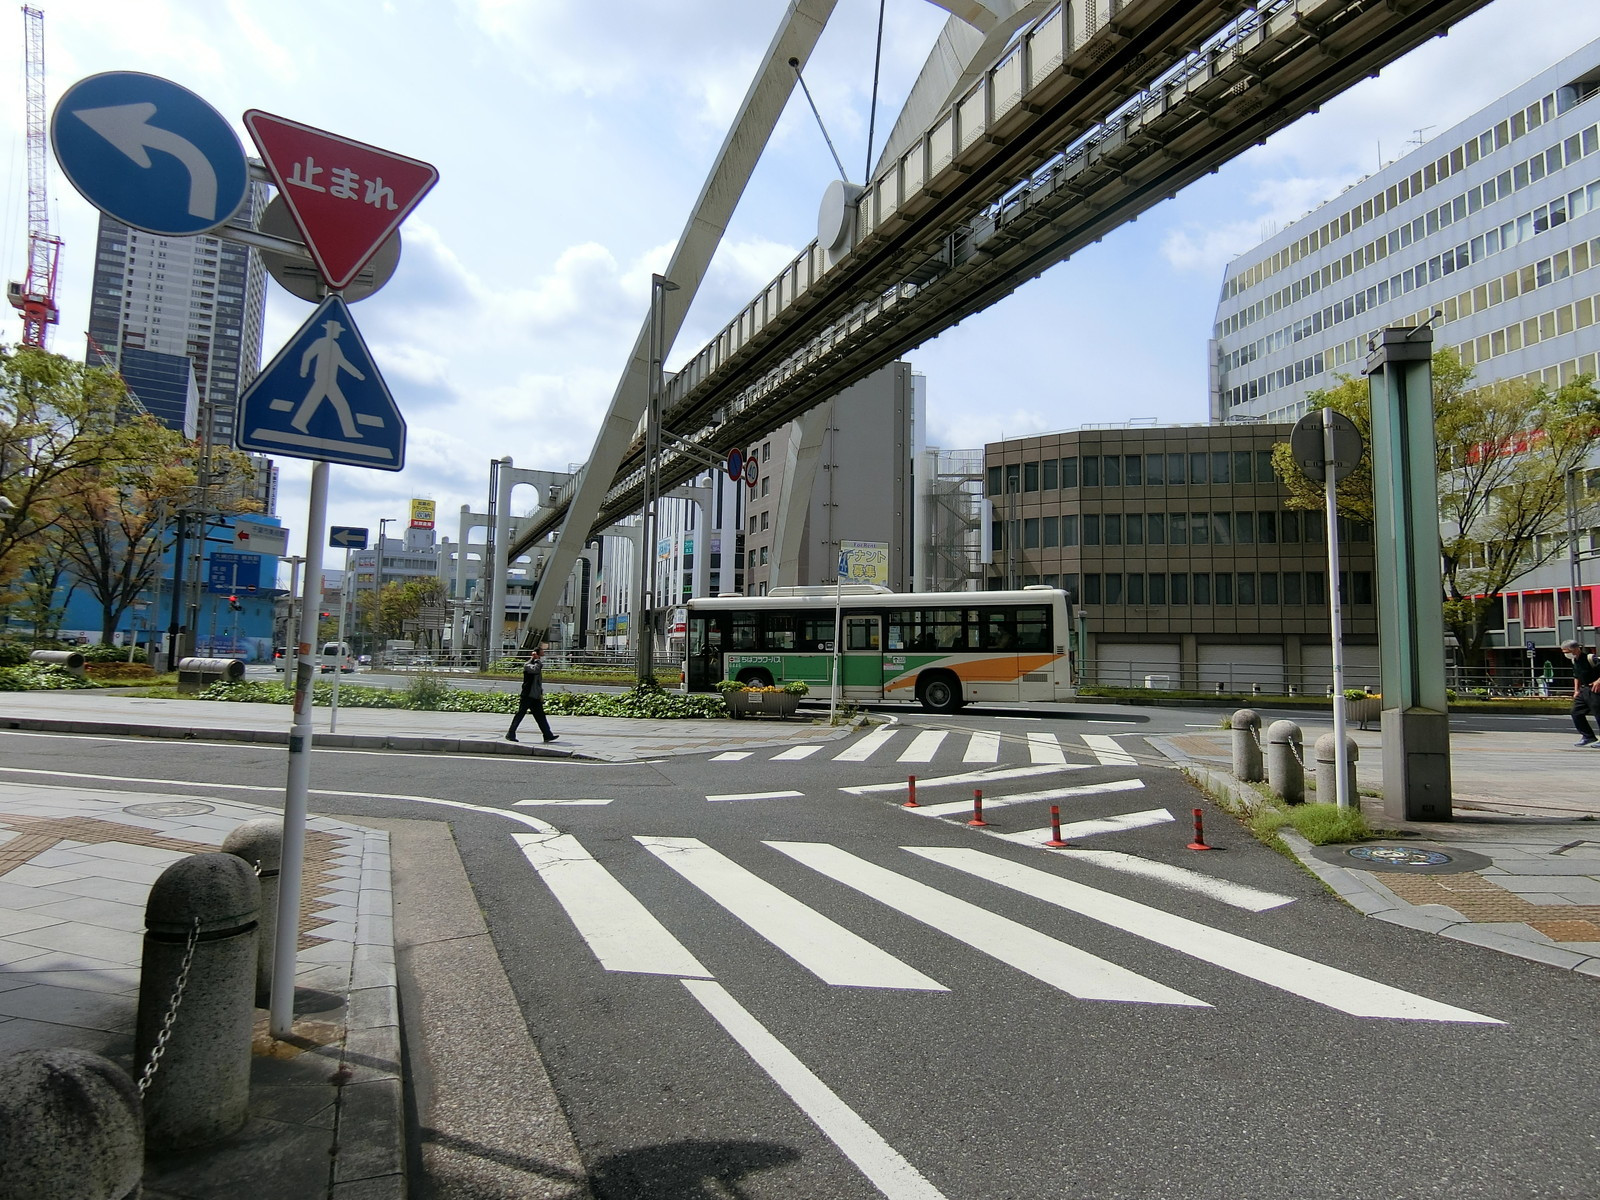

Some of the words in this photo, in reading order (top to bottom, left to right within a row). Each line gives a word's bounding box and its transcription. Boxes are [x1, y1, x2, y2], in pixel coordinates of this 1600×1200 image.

[286, 156, 399, 211] 止まれ
[748, 465, 756, 480] 40
[852, 564, 877, 578] 募集
[741, 656, 782, 664] ちばフラワーバス
